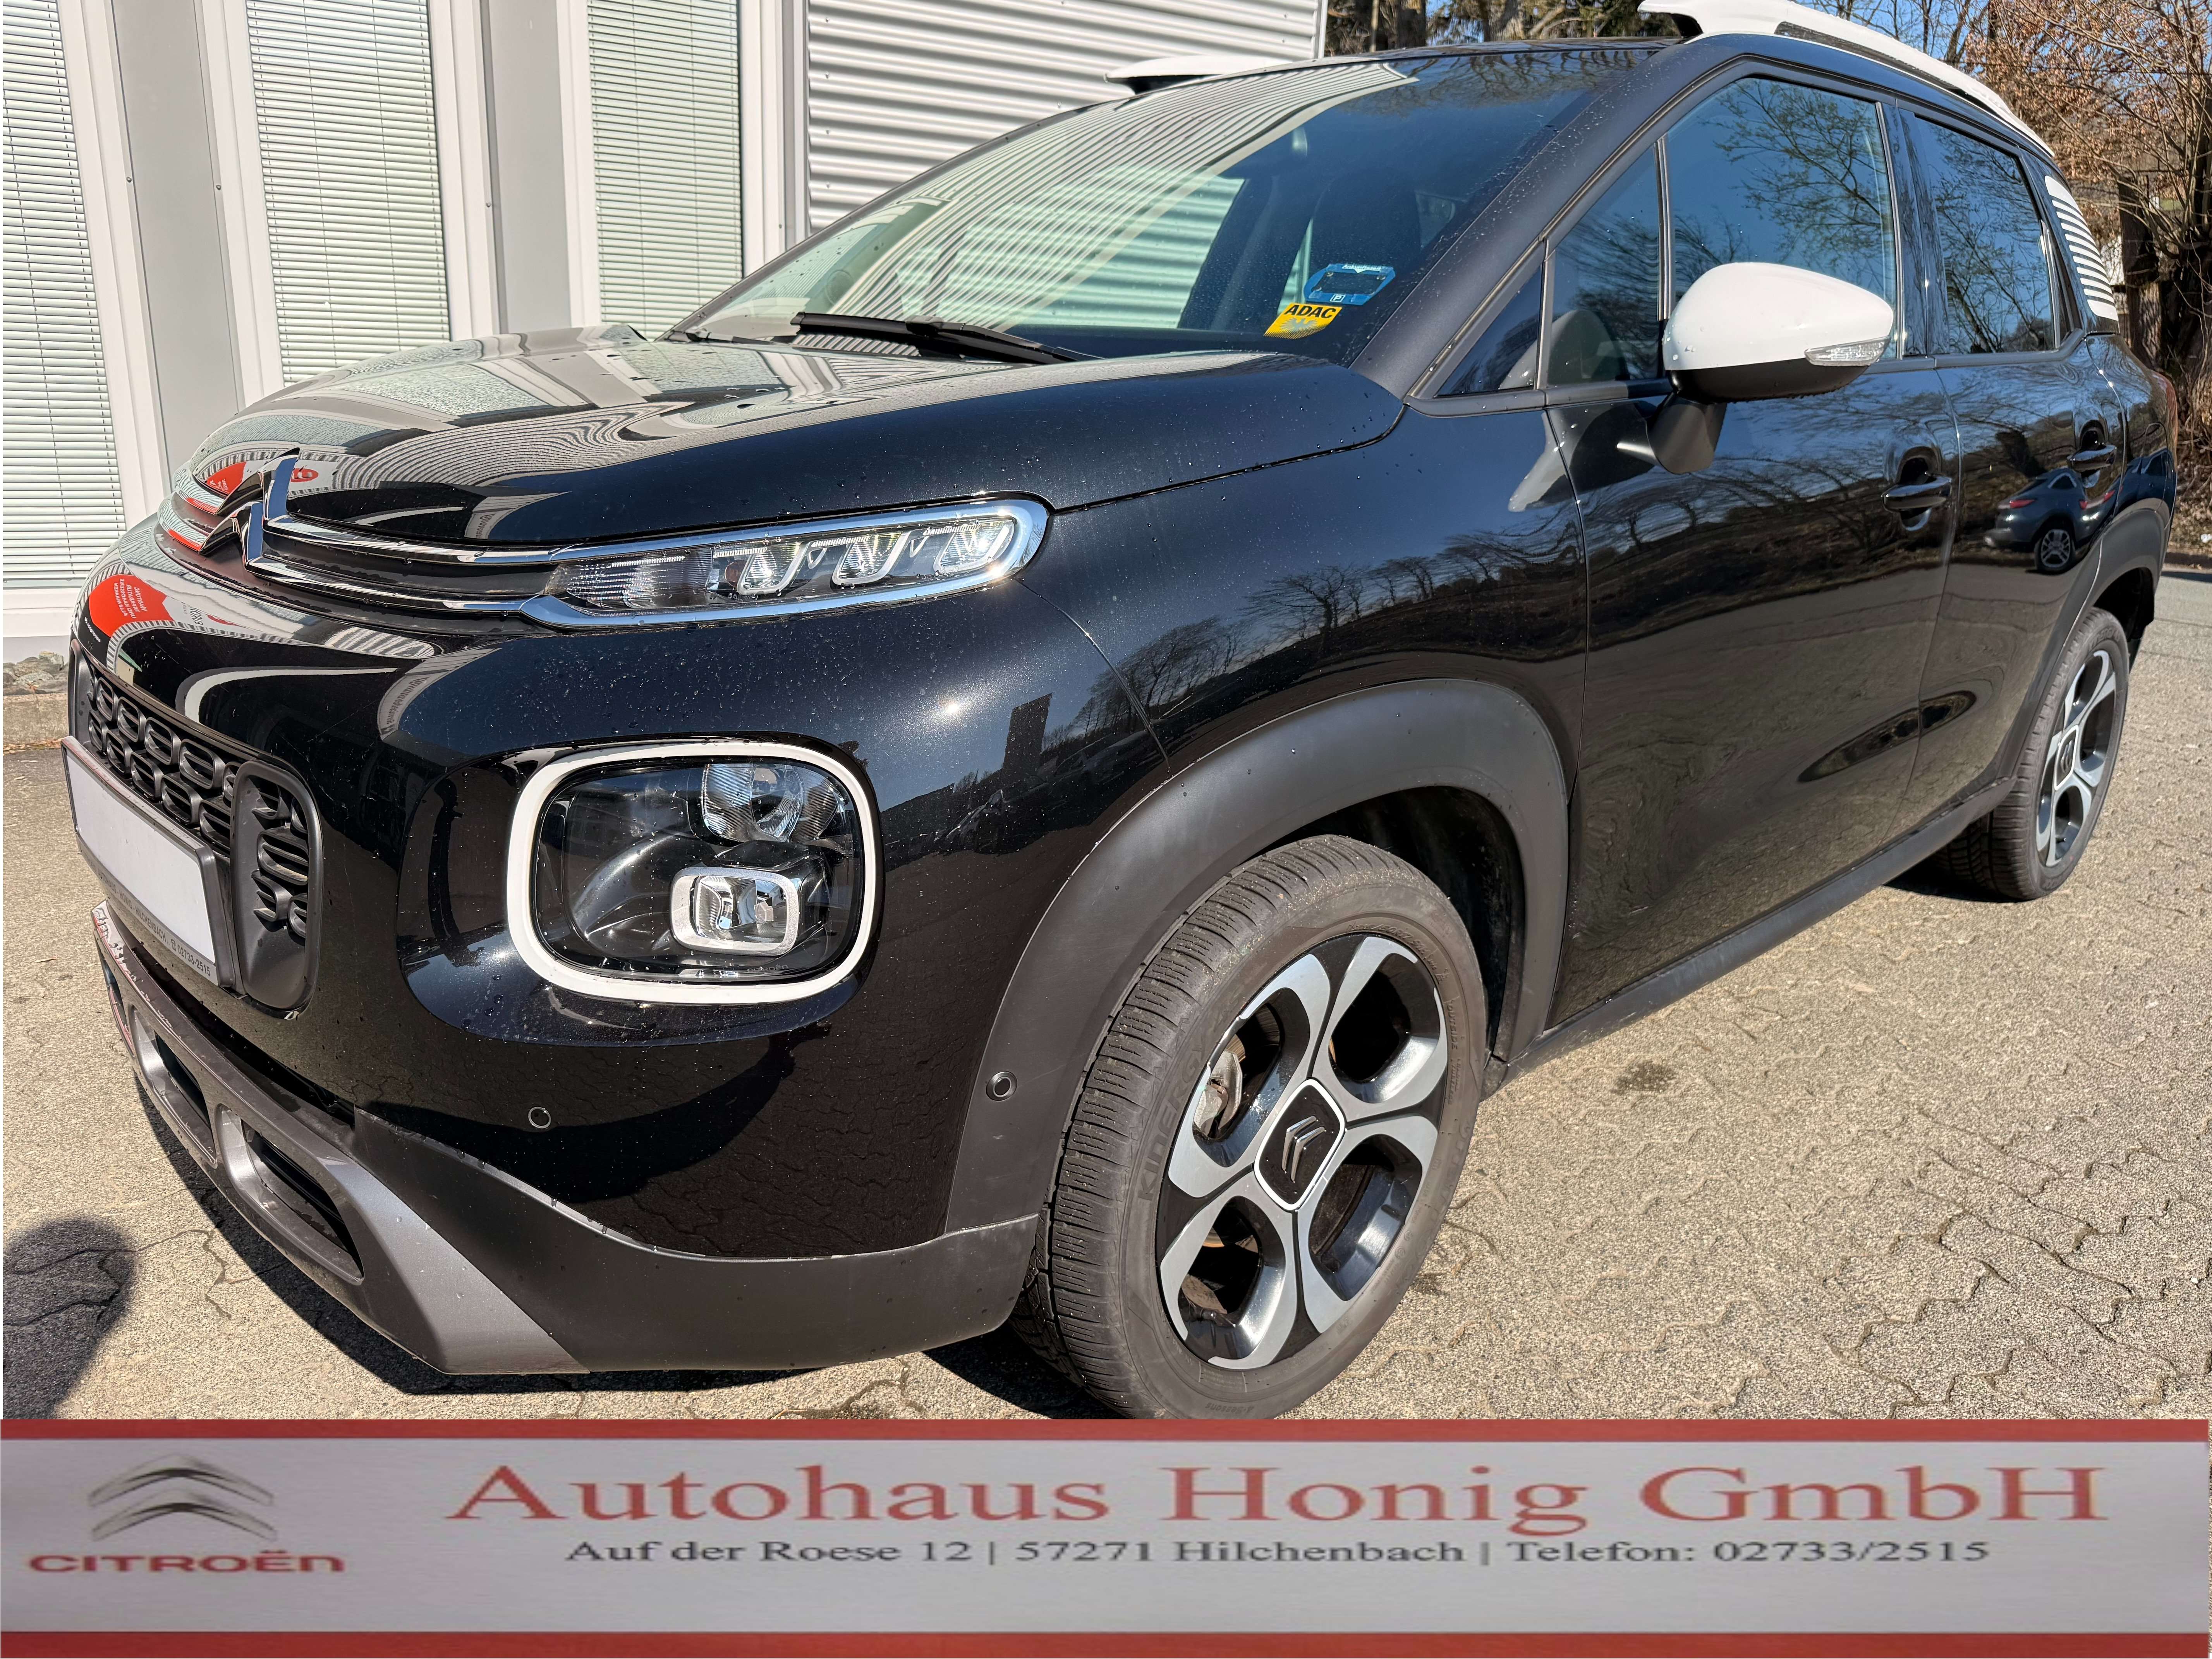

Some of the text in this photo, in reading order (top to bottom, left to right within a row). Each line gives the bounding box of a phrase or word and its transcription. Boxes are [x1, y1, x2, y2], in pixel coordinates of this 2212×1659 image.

[1283, 304, 1337, 319] ADAC
[136, 906, 167, 943] HILCHENBACH
[177, 944, 211, 977] 02733-2515
[1446, 1005, 1460, 1050] OUTSIDE
[1138, 1033, 1204, 1201] KINERGY
